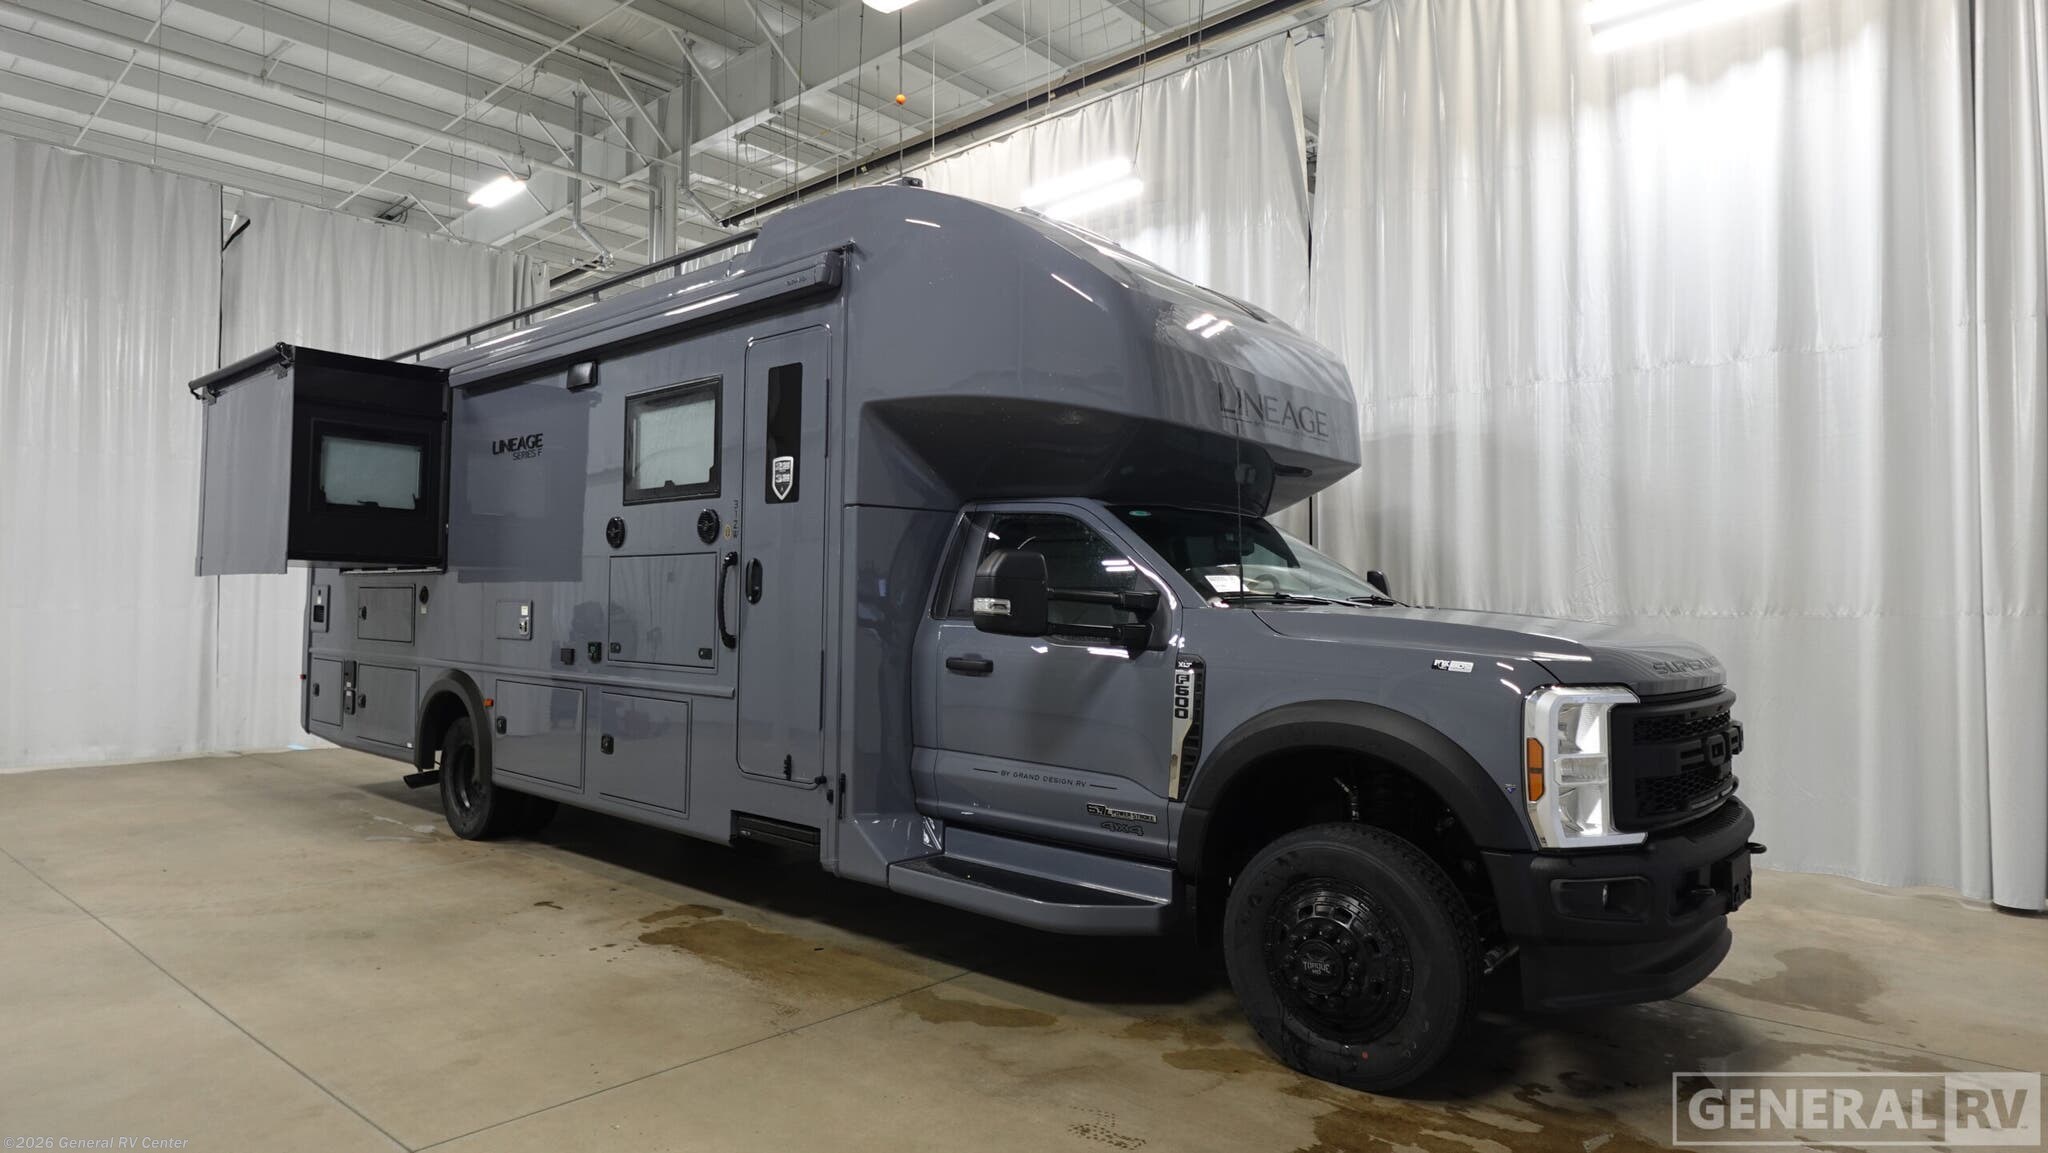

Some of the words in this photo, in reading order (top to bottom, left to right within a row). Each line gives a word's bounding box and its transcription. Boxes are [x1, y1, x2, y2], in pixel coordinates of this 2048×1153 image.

[1217, 381, 1330, 439] LINEAGE
[492, 433, 544, 456] LINEAGE
[512, 449, 537, 461] SERIES
[537, 448, 543, 457] F
[1174, 673, 1190, 720] F600
[1000, 769, 1010, 777] BY
[1012, 771, 1040, 782] GRAND
[1042, 775, 1073, 786] DESIGN
[1075, 780, 1087, 788] RV
